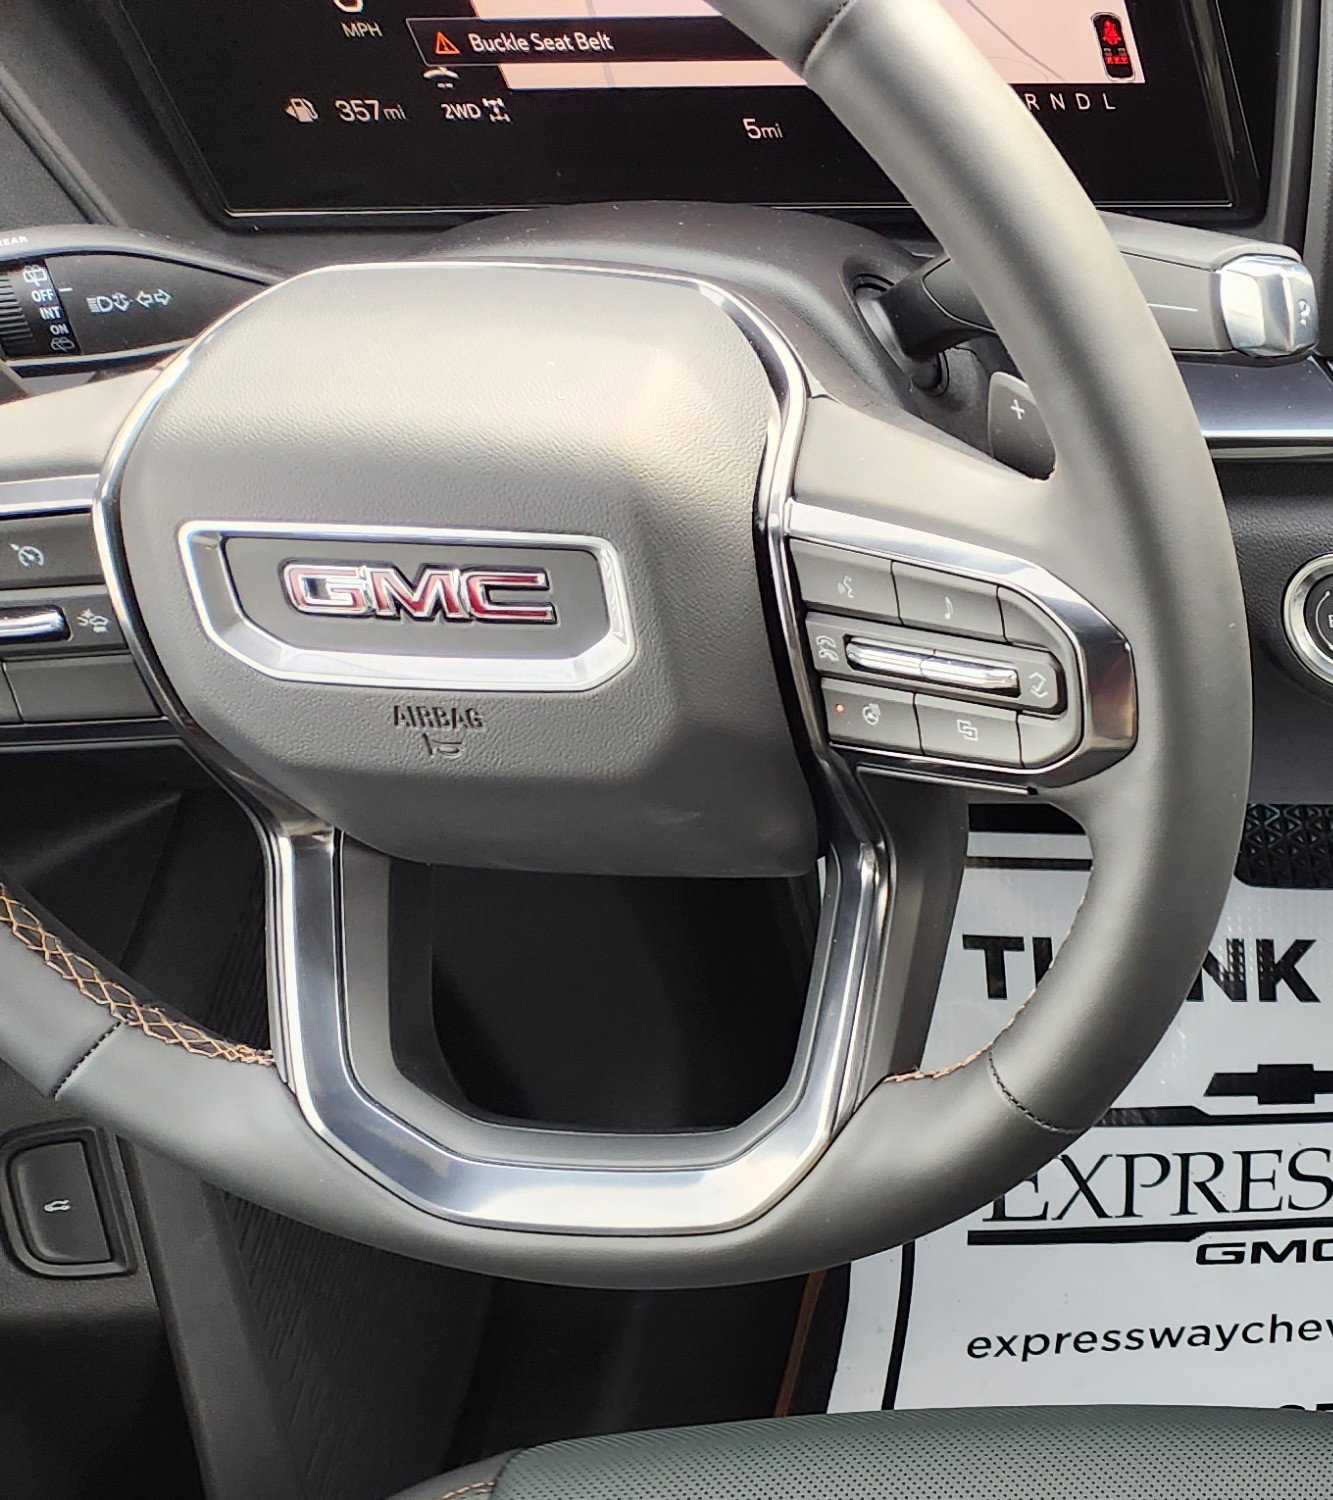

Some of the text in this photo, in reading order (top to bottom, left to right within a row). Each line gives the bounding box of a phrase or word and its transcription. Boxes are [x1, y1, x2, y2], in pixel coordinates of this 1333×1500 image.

[341, 22, 382, 38] MPH
[467, 31, 614, 53] Buckle Seat Belt
[441, 103, 481, 120] 2WD
[31, 288, 55, 302] OFF
[39, 306, 62, 320] INT
[50, 323, 69, 335] ON
[281, 559, 558, 624] GMC
[393, 704, 484, 731] AIRBAG
[962, 934, 1321, 1003] TNK
